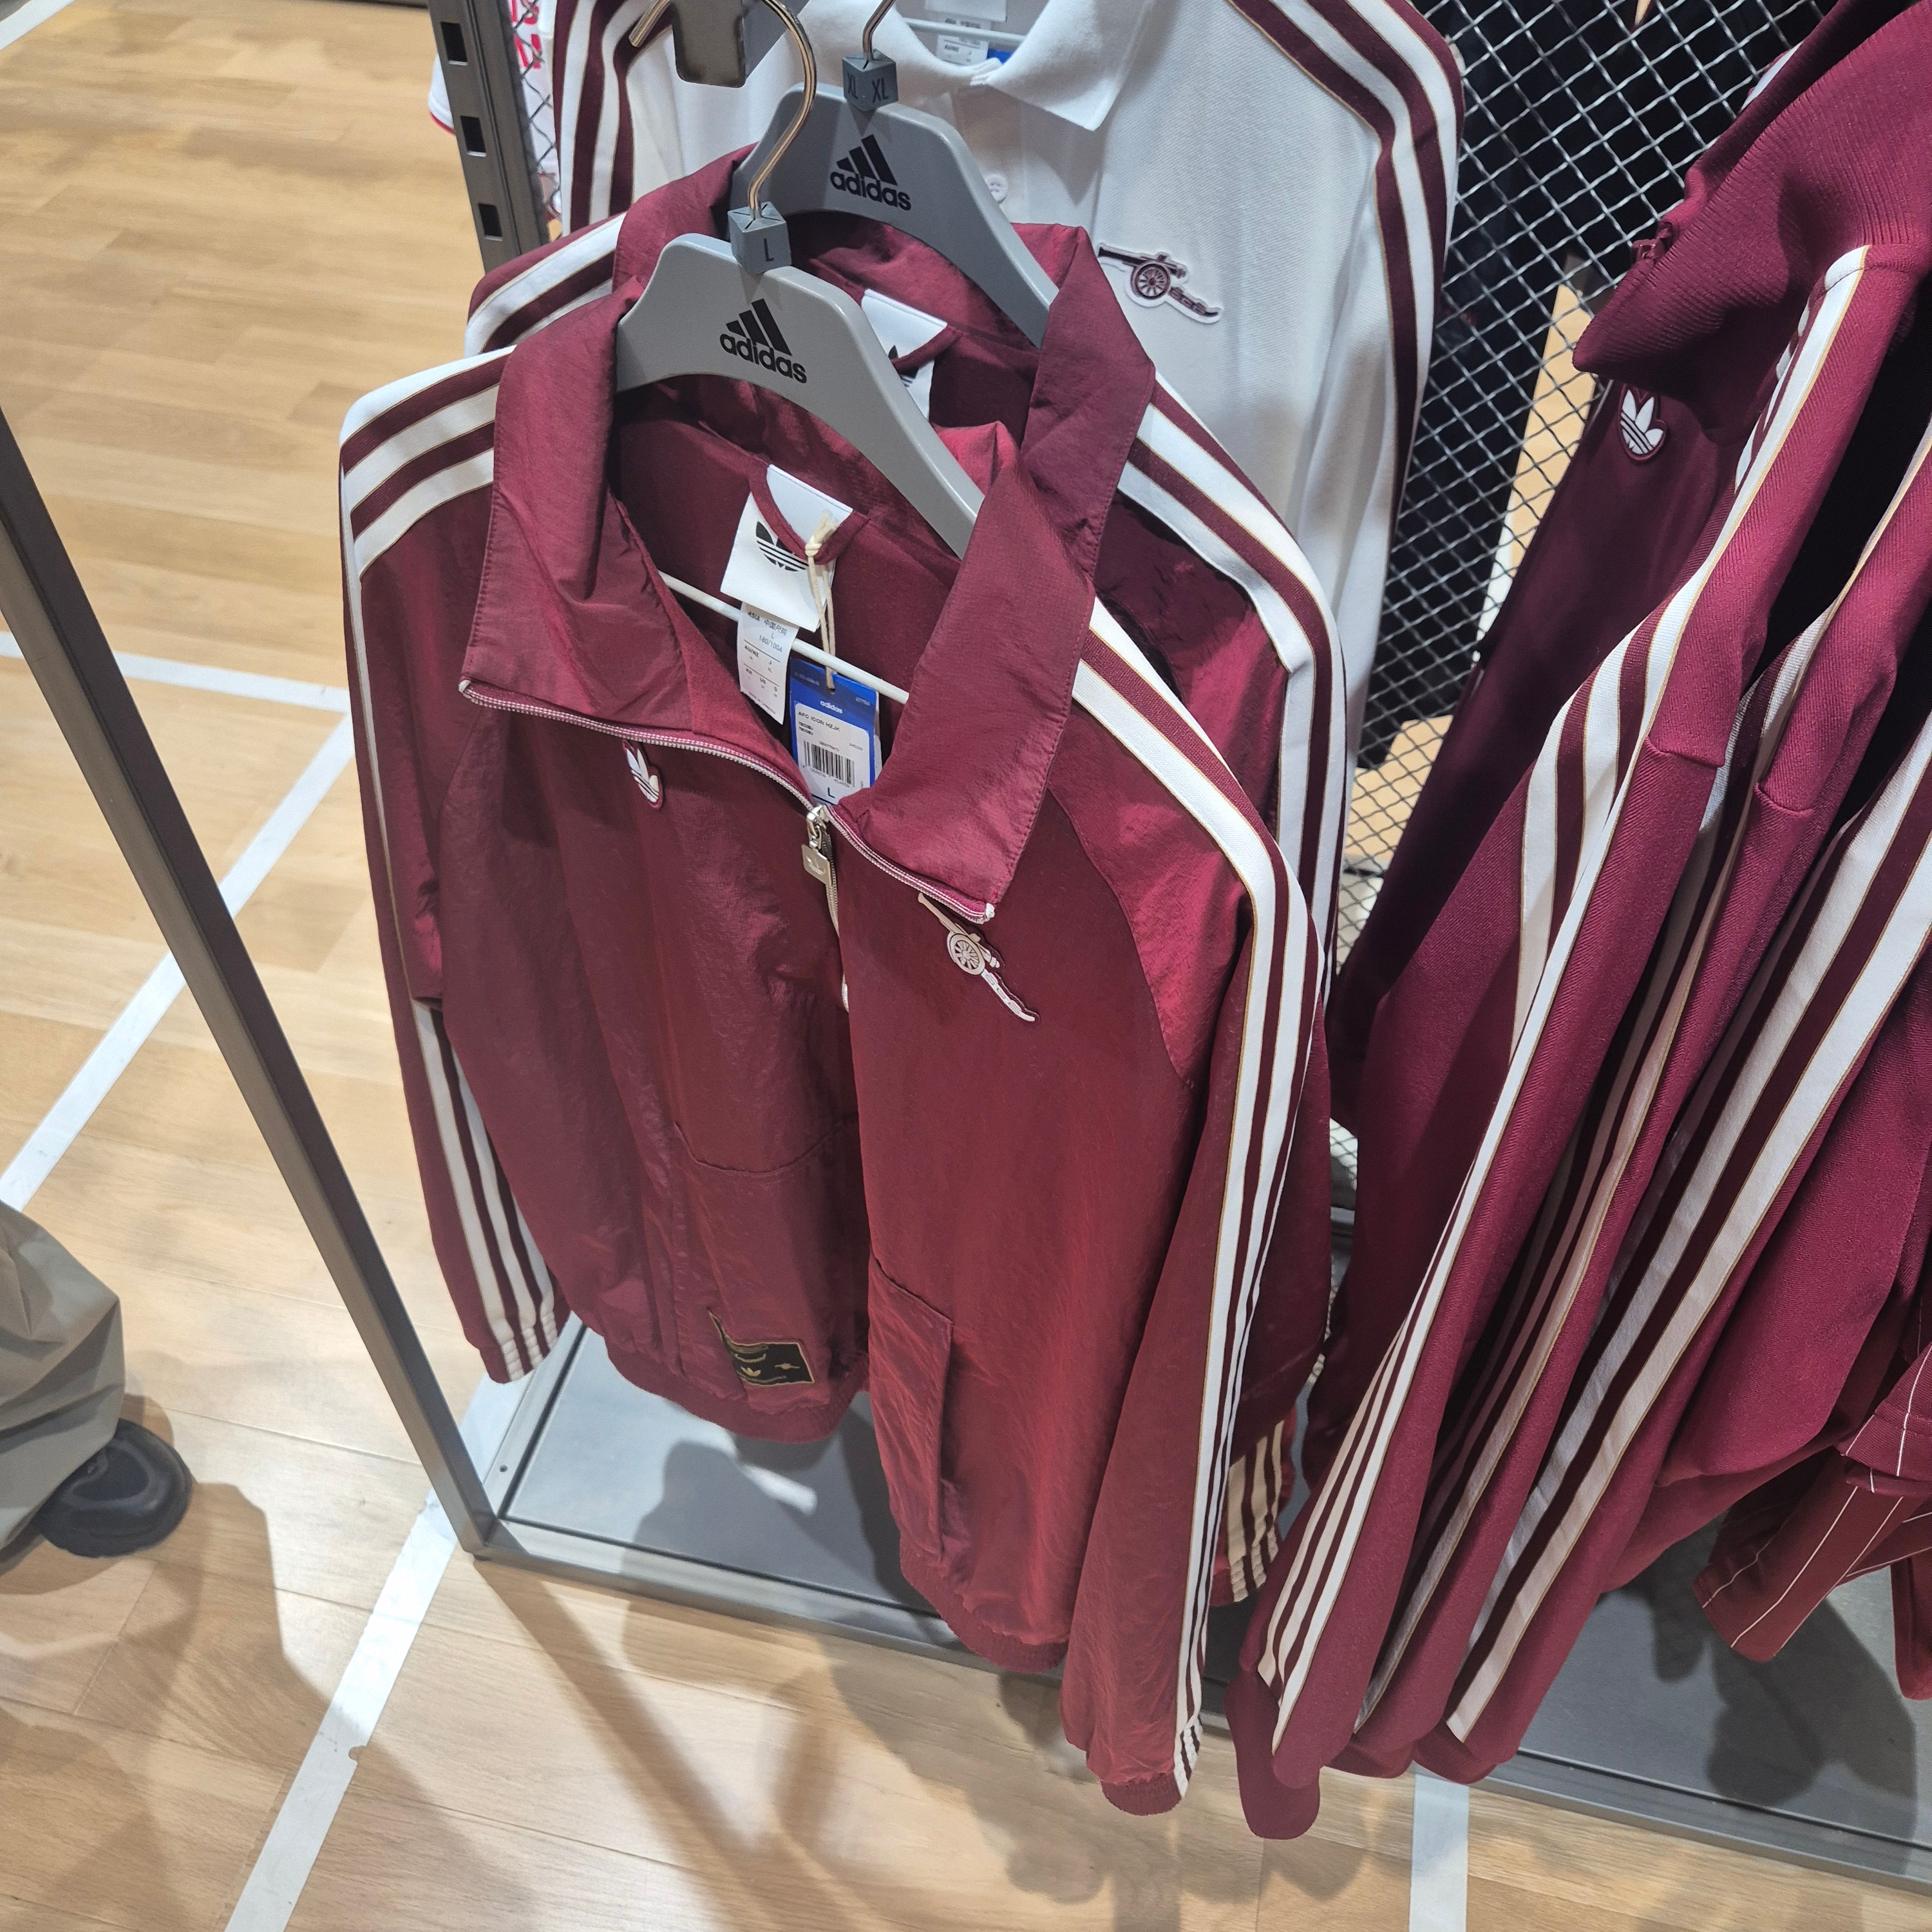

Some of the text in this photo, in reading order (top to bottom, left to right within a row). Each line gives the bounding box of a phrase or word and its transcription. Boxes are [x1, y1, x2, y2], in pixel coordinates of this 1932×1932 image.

[847, 71, 858, 100] XL
[872, 77, 889, 103] XL
[830, 171, 912, 211] adidas
[764, 238, 775, 262] L
[719, 334, 808, 384] adidas
[798, 711, 810, 719] AFC
[811, 715, 824, 725] ICON
[827, 786, 835, 799] L
